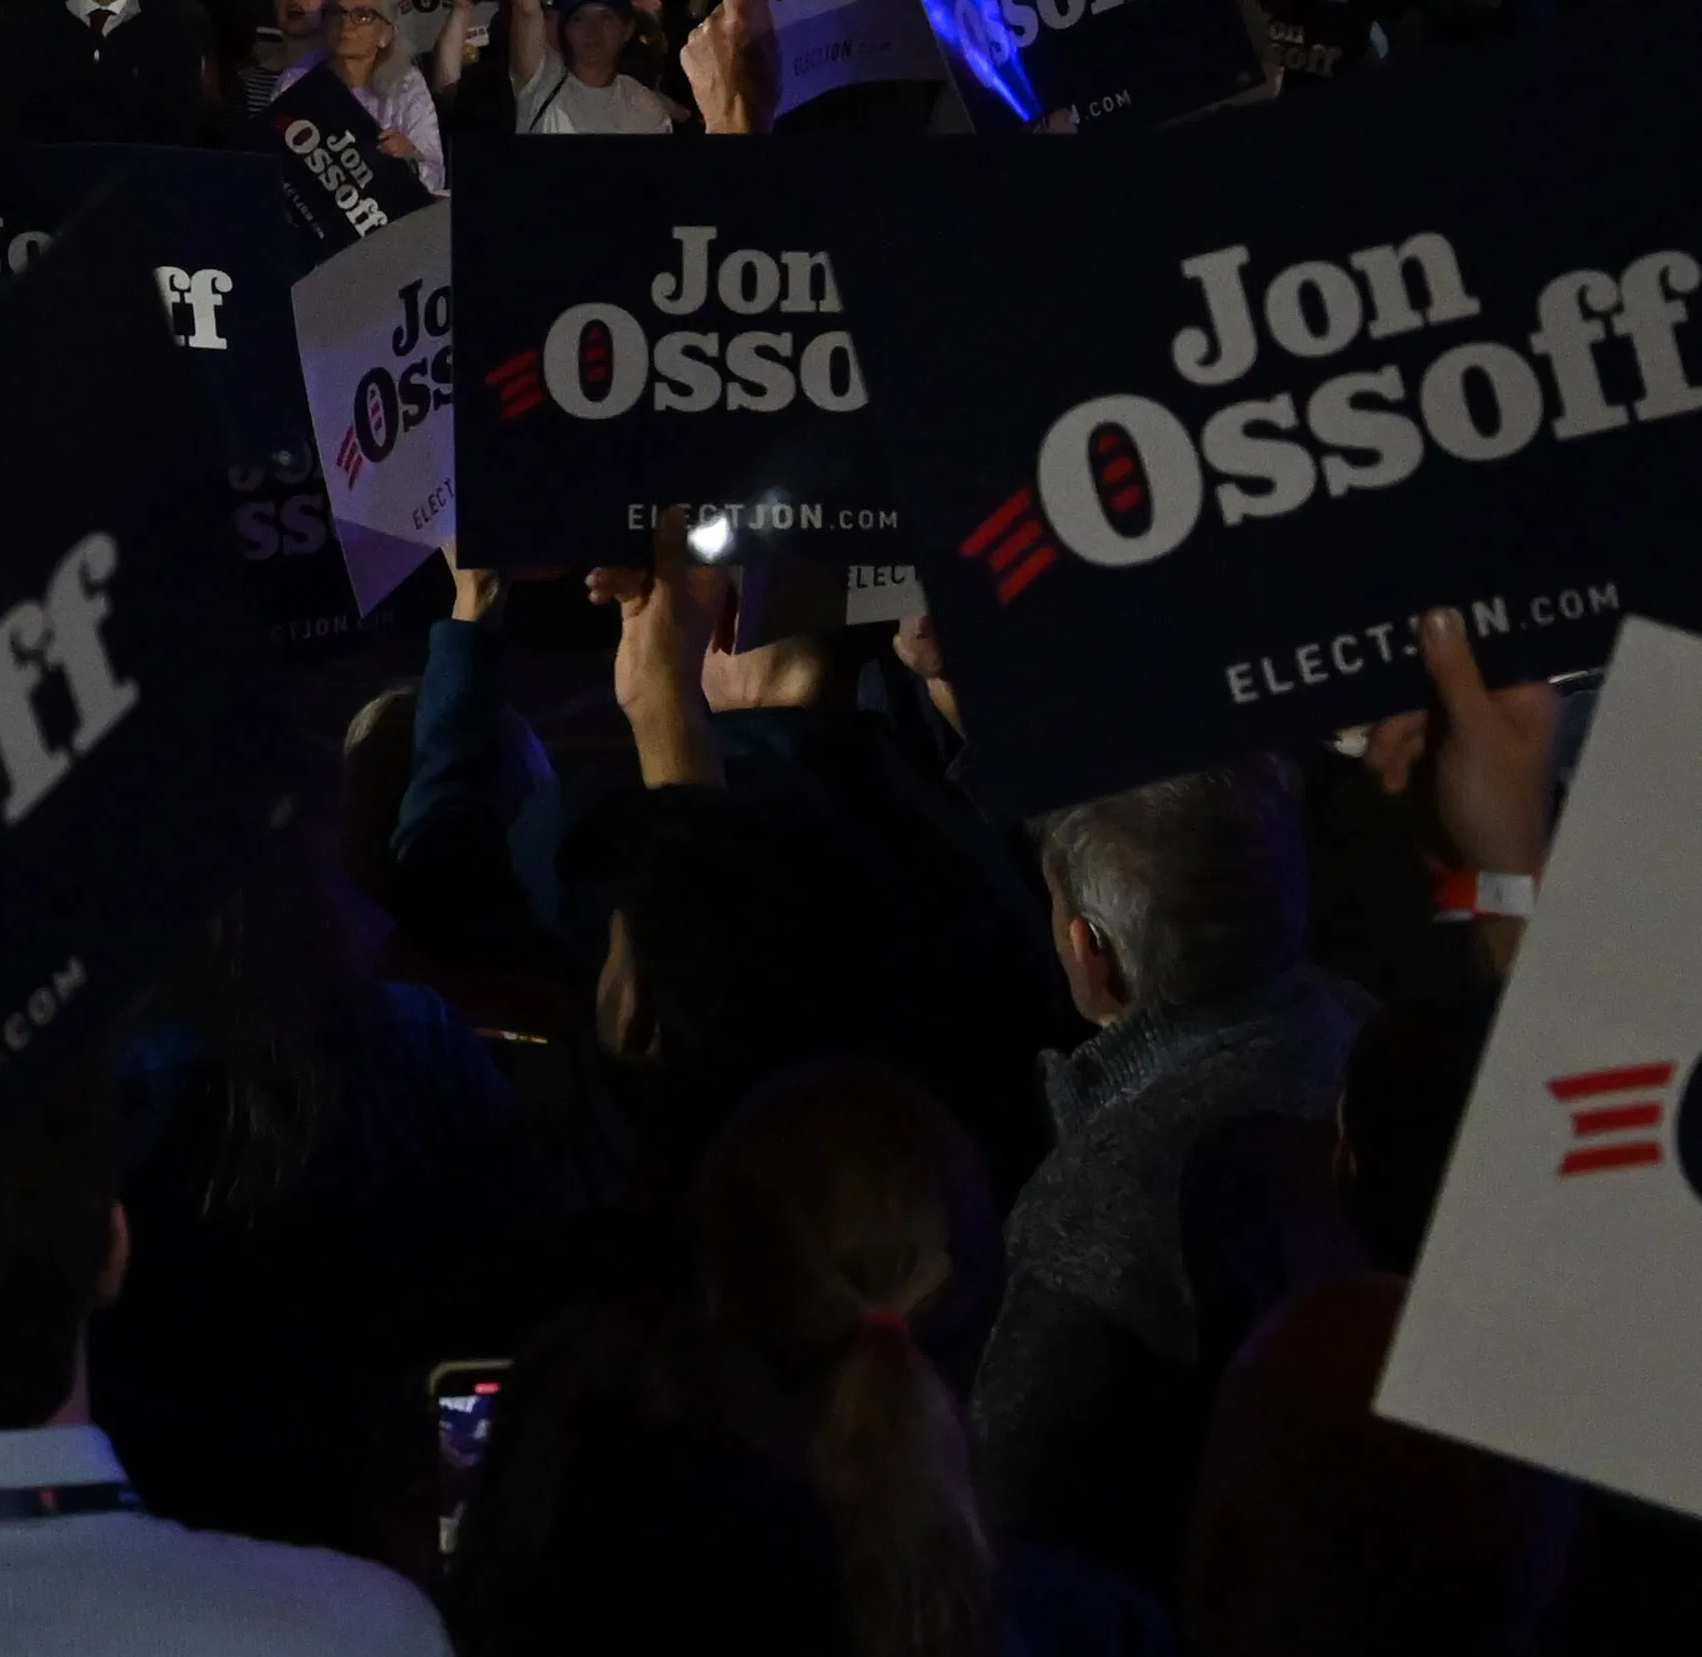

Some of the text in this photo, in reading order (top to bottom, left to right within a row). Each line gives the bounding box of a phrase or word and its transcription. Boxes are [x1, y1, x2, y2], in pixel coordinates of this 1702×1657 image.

[283, 118, 391, 239] Ossoff
[326, 129, 378, 190] Jon
[647, 221, 846, 318] Jon
[1167, 228, 1483, 390] Jon
[541, 298, 871, 423] Osso
[1033, 249, 1702, 572] Ossoff
